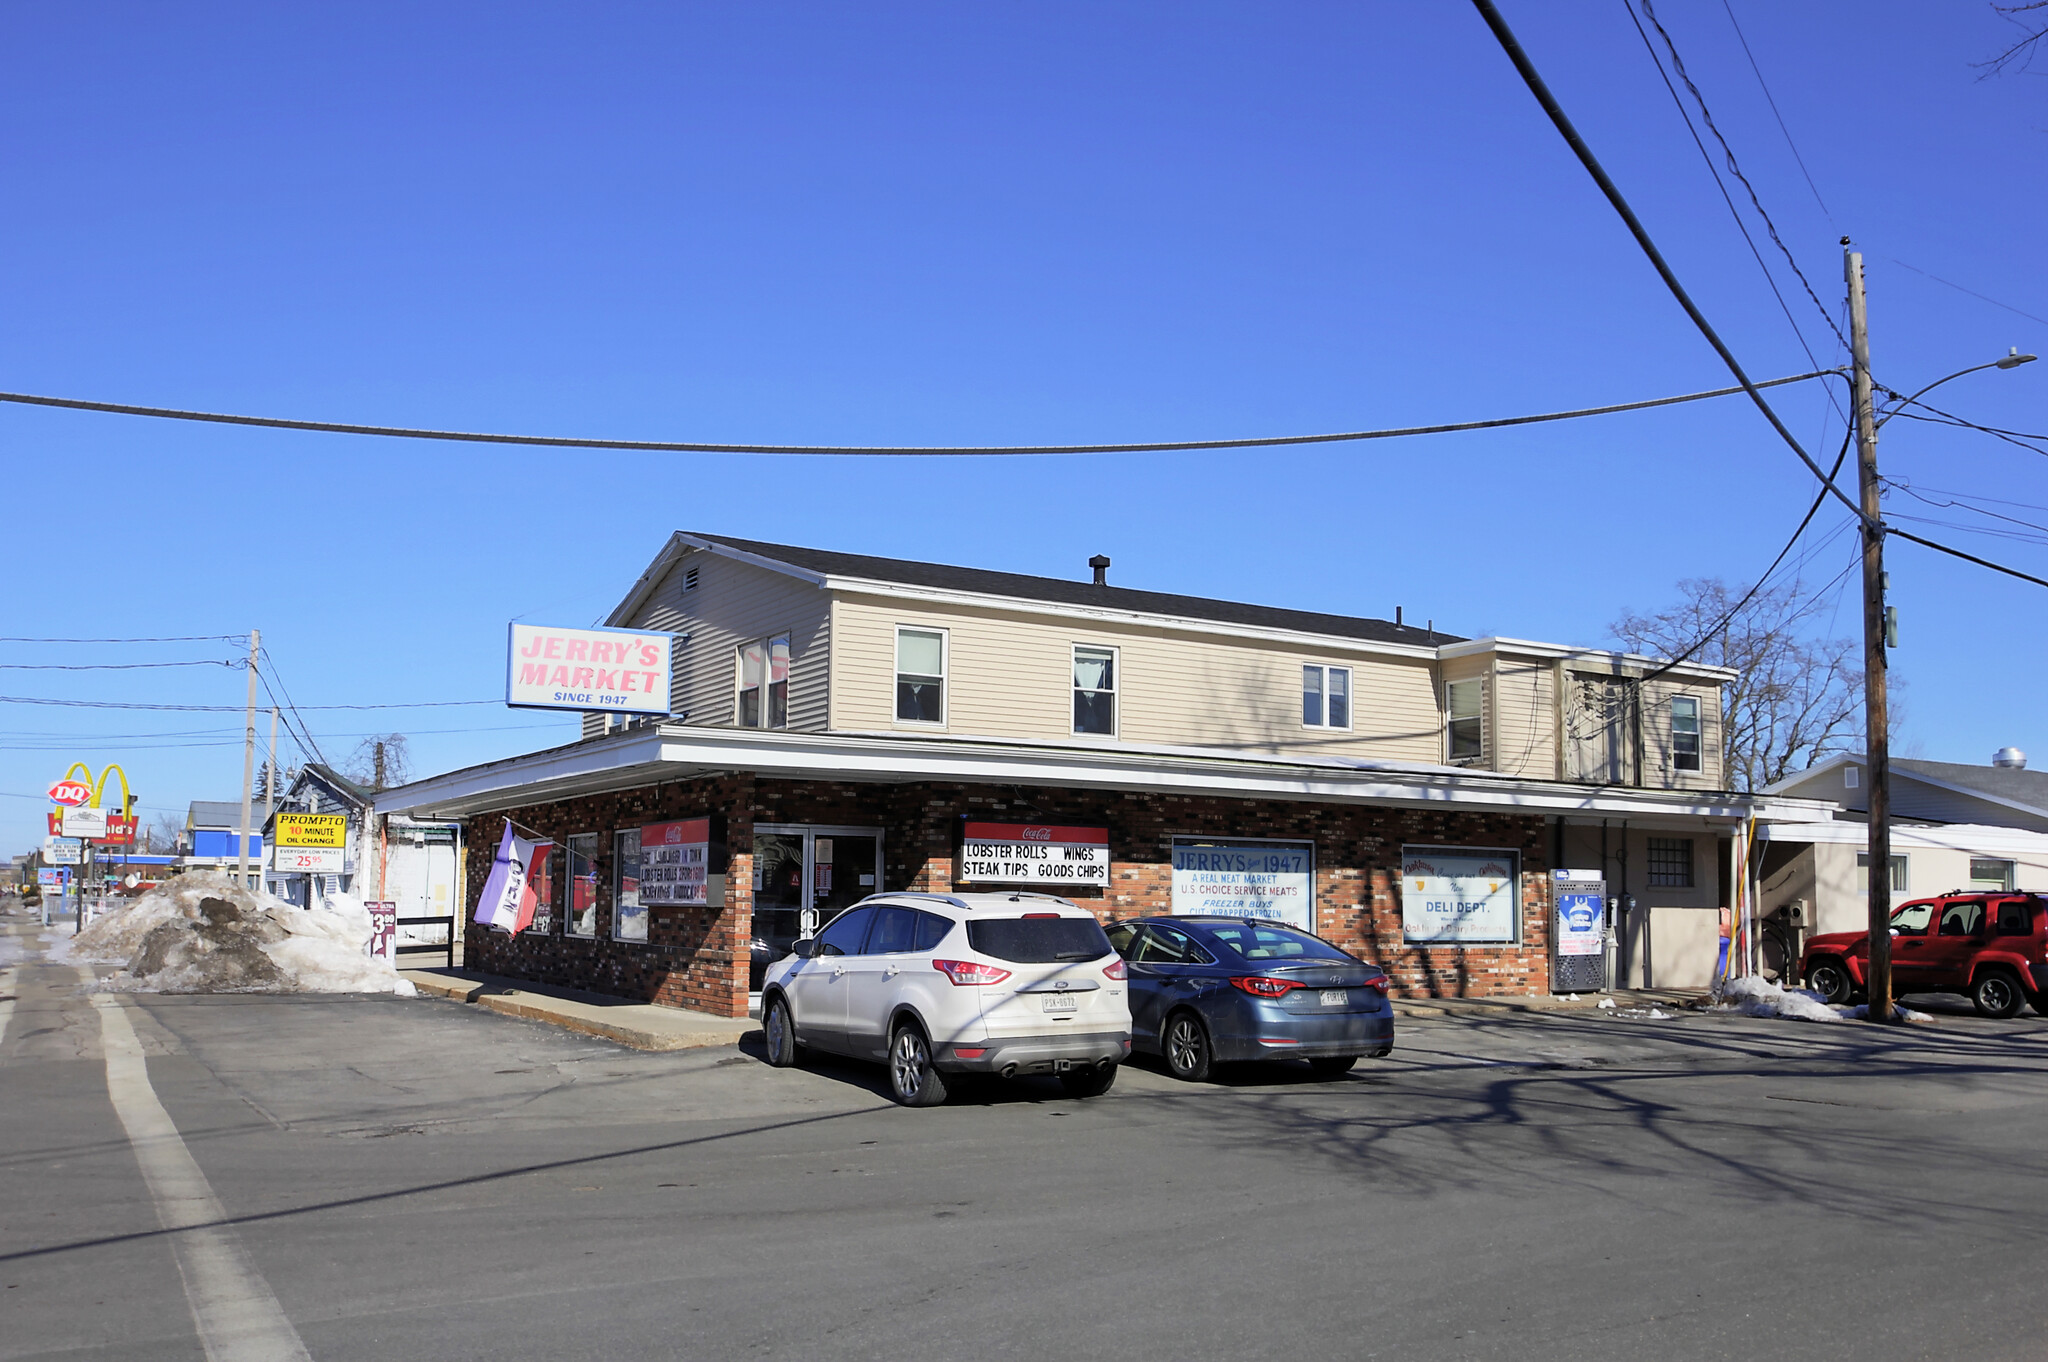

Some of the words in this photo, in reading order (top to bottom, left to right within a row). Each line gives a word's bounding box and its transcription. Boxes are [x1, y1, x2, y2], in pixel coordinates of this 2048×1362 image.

[521, 635, 661, 667] JERRY'S
[519, 663, 661, 694] MARKET
[553, 691, 594, 704] SINCE
[599, 694, 628, 705] 1947
[55, 785, 86, 802] DQ
[279, 815, 344, 826] PROMPTO
[289, 826, 302, 835] 10
[305, 828, 335, 837] MINUTE
[966, 844, 1012, 858] LOBSTER
[1015, 846, 1048, 860] ROLLS
[1063, 847, 1095, 861] WINGS
[964, 861, 1000, 875] STEAK
[1003, 863, 1029, 877] TIPS
[1038, 864, 1074, 878] GOODS
[1077, 865, 1105, 878] CHIPS
[1264, 855, 1302, 874] 1947
[1192, 873, 1198, 883] A
[1200, 873, 1218, 883] REAL
[1221, 874, 1240, 884] MEAT
[1244, 874, 1277, 884] MARKET
[1199, 884, 1232, 895] CHOICE
[1234, 886, 1267, 896] SERVICE
[1269, 887, 1298, 897] MEATS
[1202, 899, 1244, 908] FREEZER
[1248, 900, 1273, 908] BUYS
[1426, 901, 1453, 912] DELI
[1457, 901, 1490, 913] DEPT.
